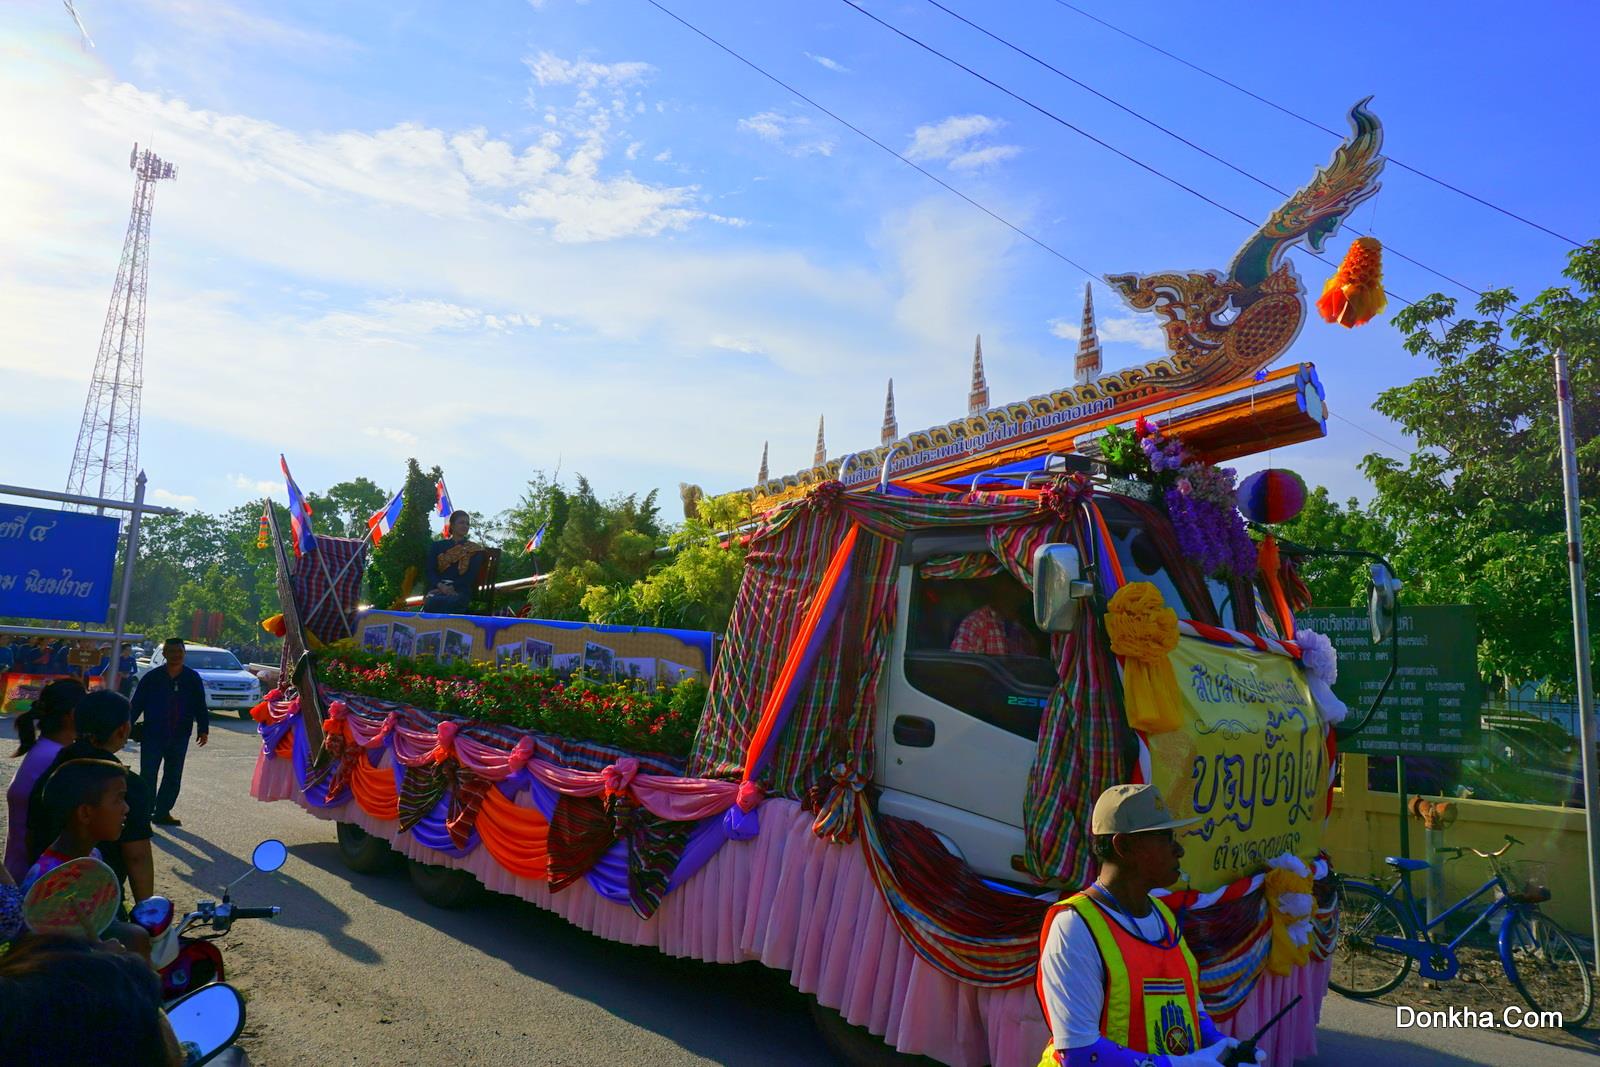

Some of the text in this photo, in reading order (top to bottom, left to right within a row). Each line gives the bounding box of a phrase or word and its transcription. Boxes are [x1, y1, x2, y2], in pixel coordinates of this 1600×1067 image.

[1021, 396, 1115, 433] ตำบลดอนคา
[24, 568, 94, 598] นิยมไทย
